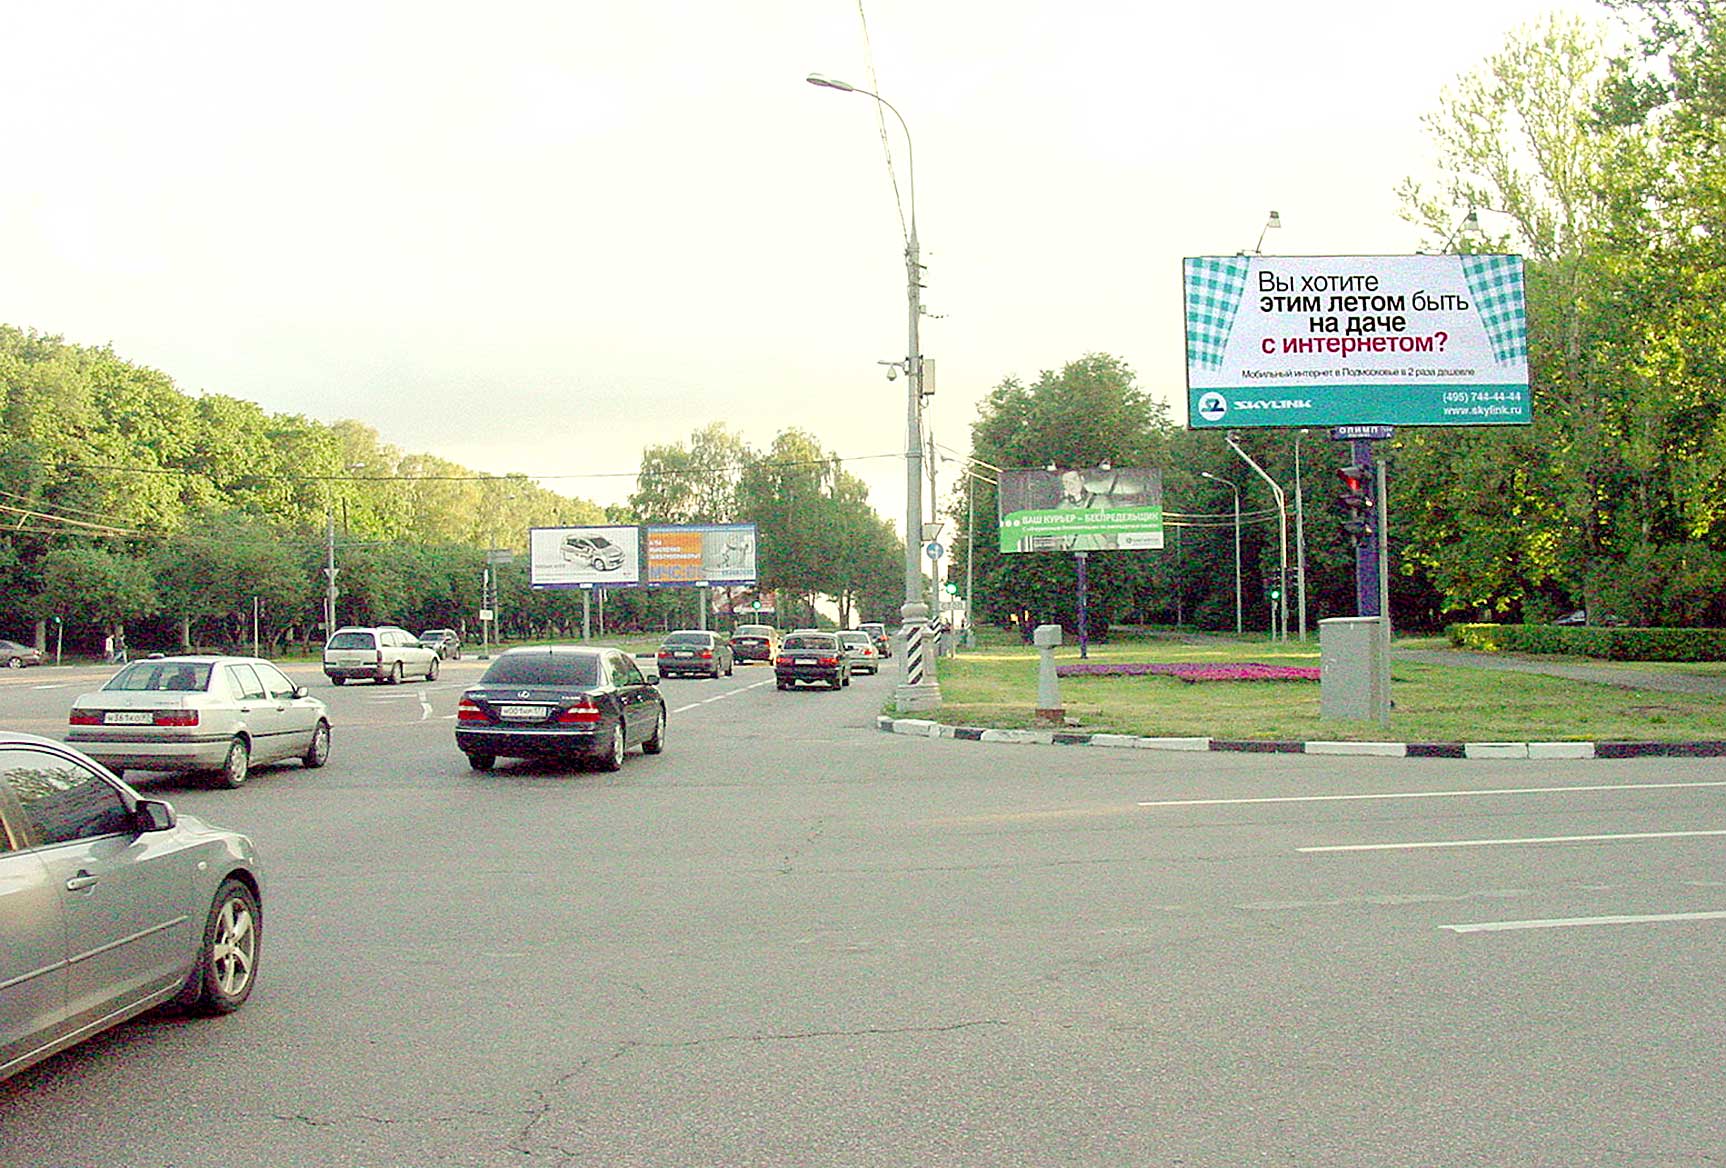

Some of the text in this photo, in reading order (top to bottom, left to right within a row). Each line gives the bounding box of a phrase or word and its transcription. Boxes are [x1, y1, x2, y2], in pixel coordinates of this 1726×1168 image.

[1258, 270, 1379, 292] Вы хотите
[1260, 289, 1469, 312] этим летом быть
[1309, 315, 1407, 336] на даче
[1261, 331, 1449, 358] с интернетом?
[1241, 369, 1293, 379] Мобильный
[1294, 369, 1334, 379] интернет
[1342, 367, 1400, 378] Подмосковье
[1408, 367, 1415, 376] 2
[1415, 368, 1436, 378] раза
[1437, 367, 1476, 377] дешевле
[1233, 399, 1313, 410] SKYLINK
[1442, 391, 1522, 404] (495) 744-44-44
[1443, 405, 1523, 417] www.skylink.ru
